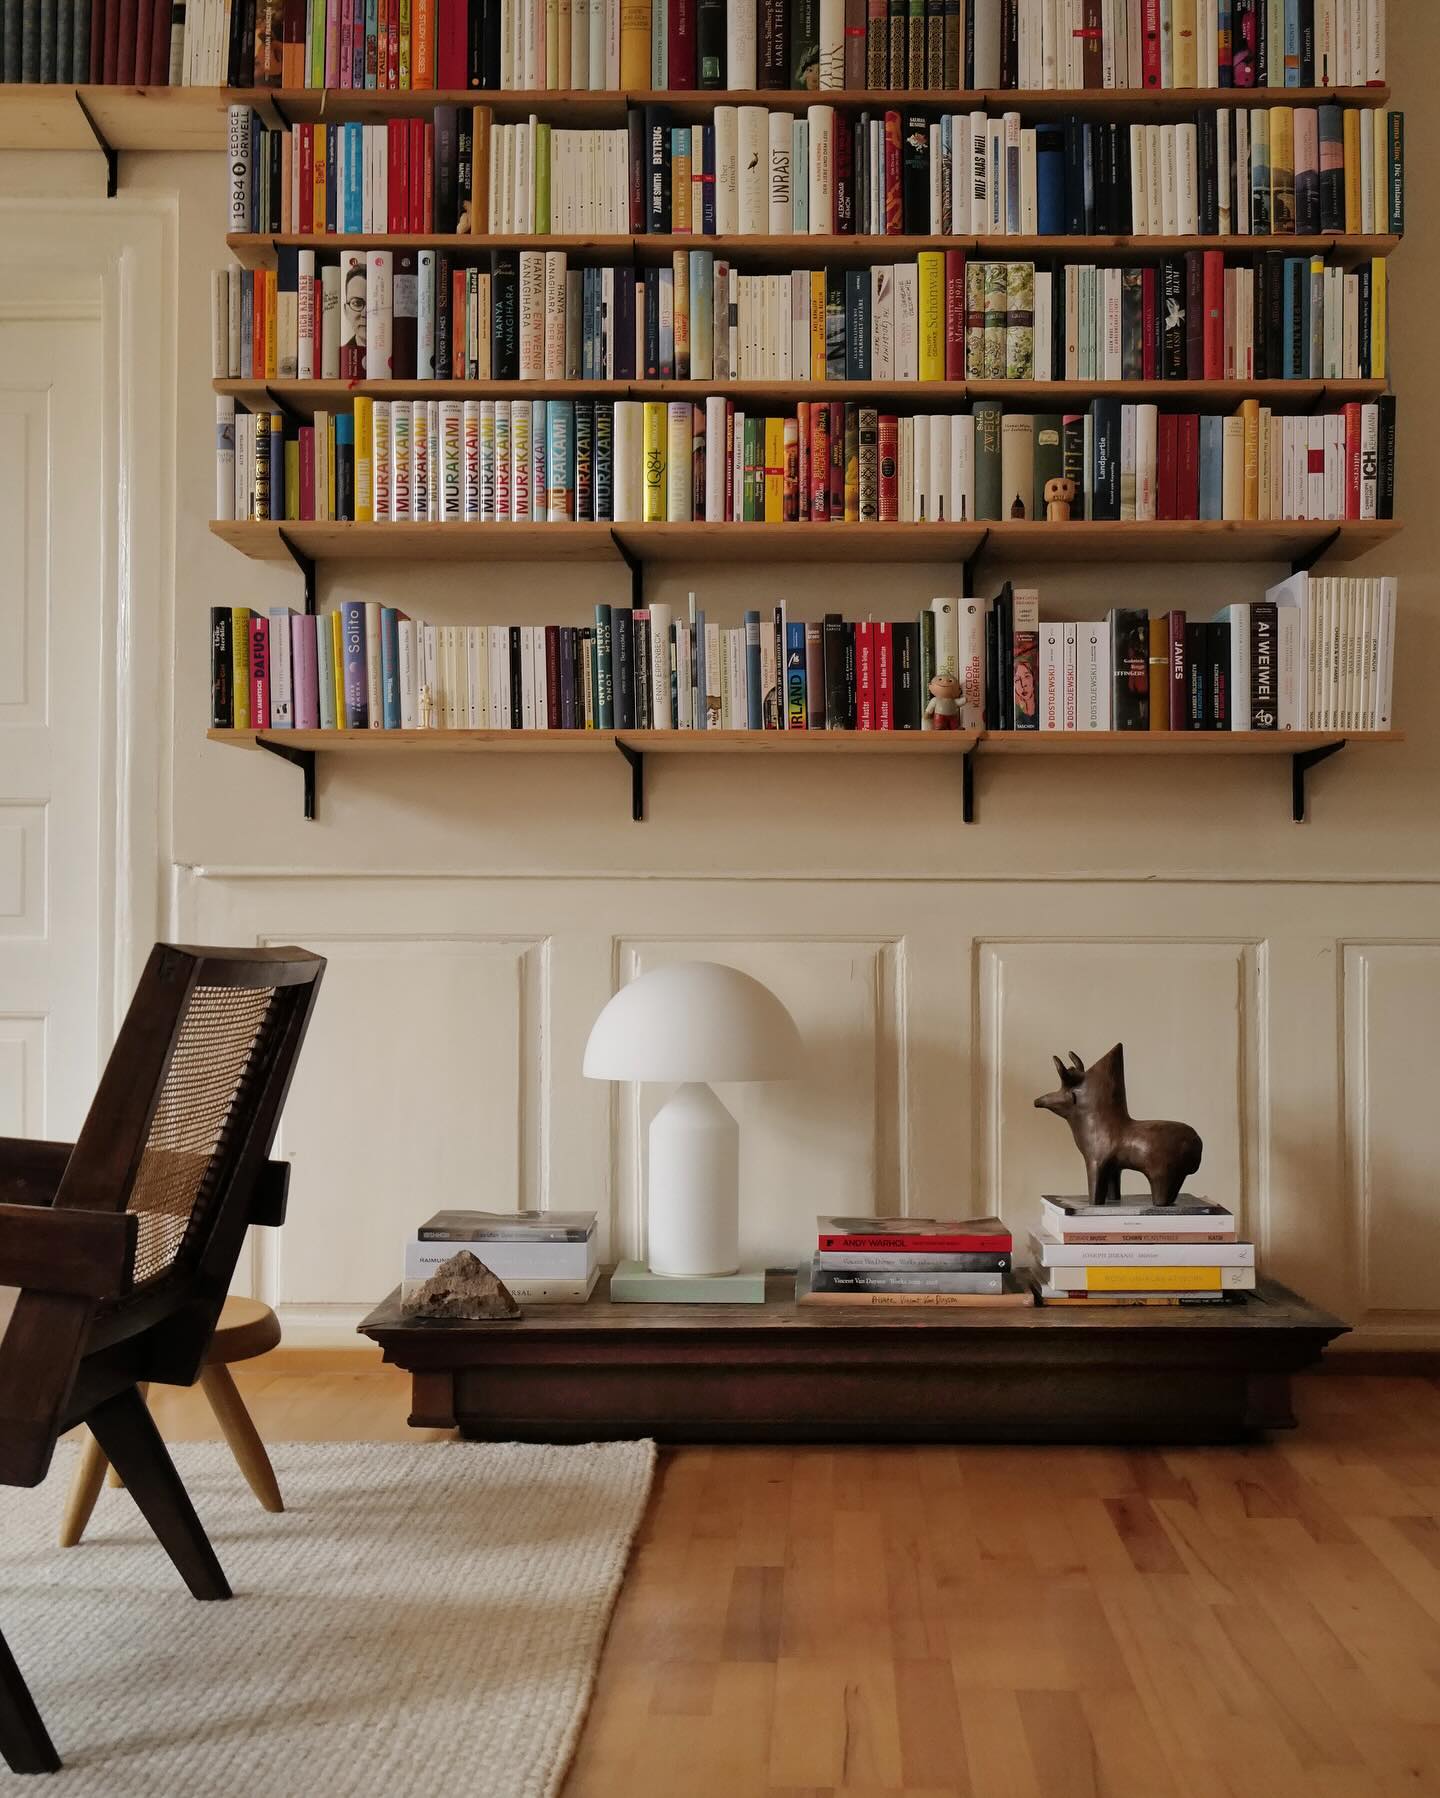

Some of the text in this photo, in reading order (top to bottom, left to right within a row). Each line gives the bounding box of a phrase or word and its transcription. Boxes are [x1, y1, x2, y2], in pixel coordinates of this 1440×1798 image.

[775, 32, 783, 66] MARIA
[231, 111, 239, 157] GEORGE
[240, 111, 249, 158] ORWELL
[652, 126, 662, 164] BETRUG
[653, 173, 662, 194] SMITH
[773, 149, 790, 203] UNRAST
[974, 135, 985, 200] WOLF HAAS MÜLL
[233, 180, 245, 220] 1984
[495, 301, 504, 338] HANYA
[506, 285, 514, 356] YANAGIHARA
[926, 258, 938, 328] Schönwald
[985, 410, 994, 452] ZWEIG
[1098, 437, 1107, 479] Landpartie
[1367, 412, 1376, 449] KEHLMANN
[376, 419, 389, 514] MURAKAMI
[395, 417, 409, 513] MURAKAMI
[415, 417, 426, 513] MURAKAMI
[428, 436, 437, 502] MURAKAMI
[445, 418, 459, 513] MURAKAMI
[467, 418, 478, 513] MURAKAMI
[483, 417, 494, 513] MURAKAMI
[498, 420, 509, 514] MURAKAMI
[515, 420, 528, 514] MURAKAMI
[552, 420, 566, 512] MURAKAMI
[578, 418, 591, 513] MURAKAMI
[598, 417, 610, 513] MURAKAMI
[1363, 451, 1376, 480] ICH
[253, 632, 266, 678] DAFUQ
[348, 610, 359, 653] Solito
[655, 632, 663, 705] JENNY ERPENBECK
[1175, 642, 1184, 679] JAMES
[1258, 622, 1269, 700] AI WEIWEI
[789, 675, 804, 729] IRLAND
[862, 701, 870, 731] Paul Auster
[880, 701, 888, 731] Paul Auster
[1048, 664, 1056, 721] DOSTOJEWSKIJ
